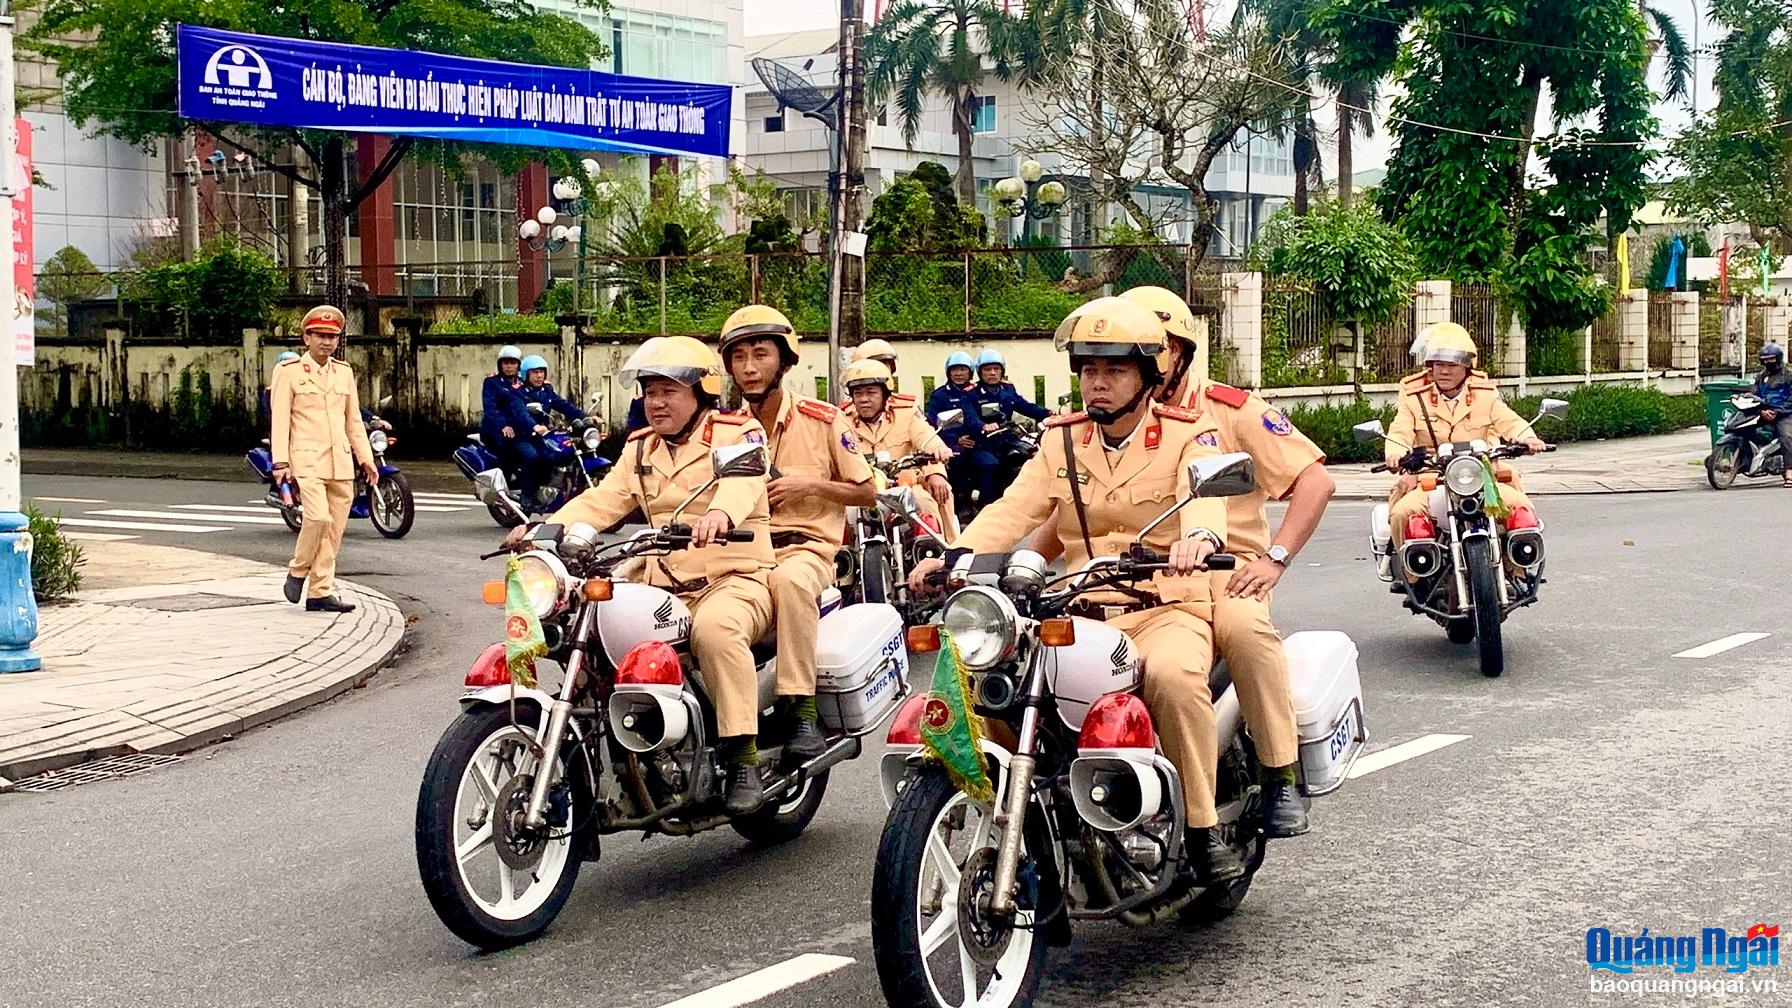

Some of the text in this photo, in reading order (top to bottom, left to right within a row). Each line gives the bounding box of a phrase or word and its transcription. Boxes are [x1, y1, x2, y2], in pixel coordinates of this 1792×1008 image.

[199, 85, 213, 93] BAN
[213, 86, 223, 95] AN
[241, 89, 256, 97] GIAO
[302, 61, 326, 102] CÁN
[327, 64, 346, 111] BỘ,
[347, 63, 378, 107] ĐẢNG
[379, 70, 404, 109] VIÊN
[406, 78, 418, 110] ĐI
[440, 79, 466, 121] THỰC
[468, 79, 492, 123] HIỆN
[493, 82, 519, 119] PHÁP
[520, 84, 543, 128] LUẬT
[544, 83, 563, 123] BẢO
[564, 86, 585, 125] ĐẢM
[585, 91, 607, 133] TRẬT
[608, 95, 621, 134] TỰ
[621, 99, 634, 129] AN
[635, 95, 657, 131] TOÀN
[657, 103, 678, 133] GIAO
[678, 100, 705, 135] THÔNG
[653, 619, 678, 631] HONDA
[881, 631, 904, 657] CSGT
[865, 675, 889, 703] TRAFFIC
[1330, 717, 1350, 761] CSGT
